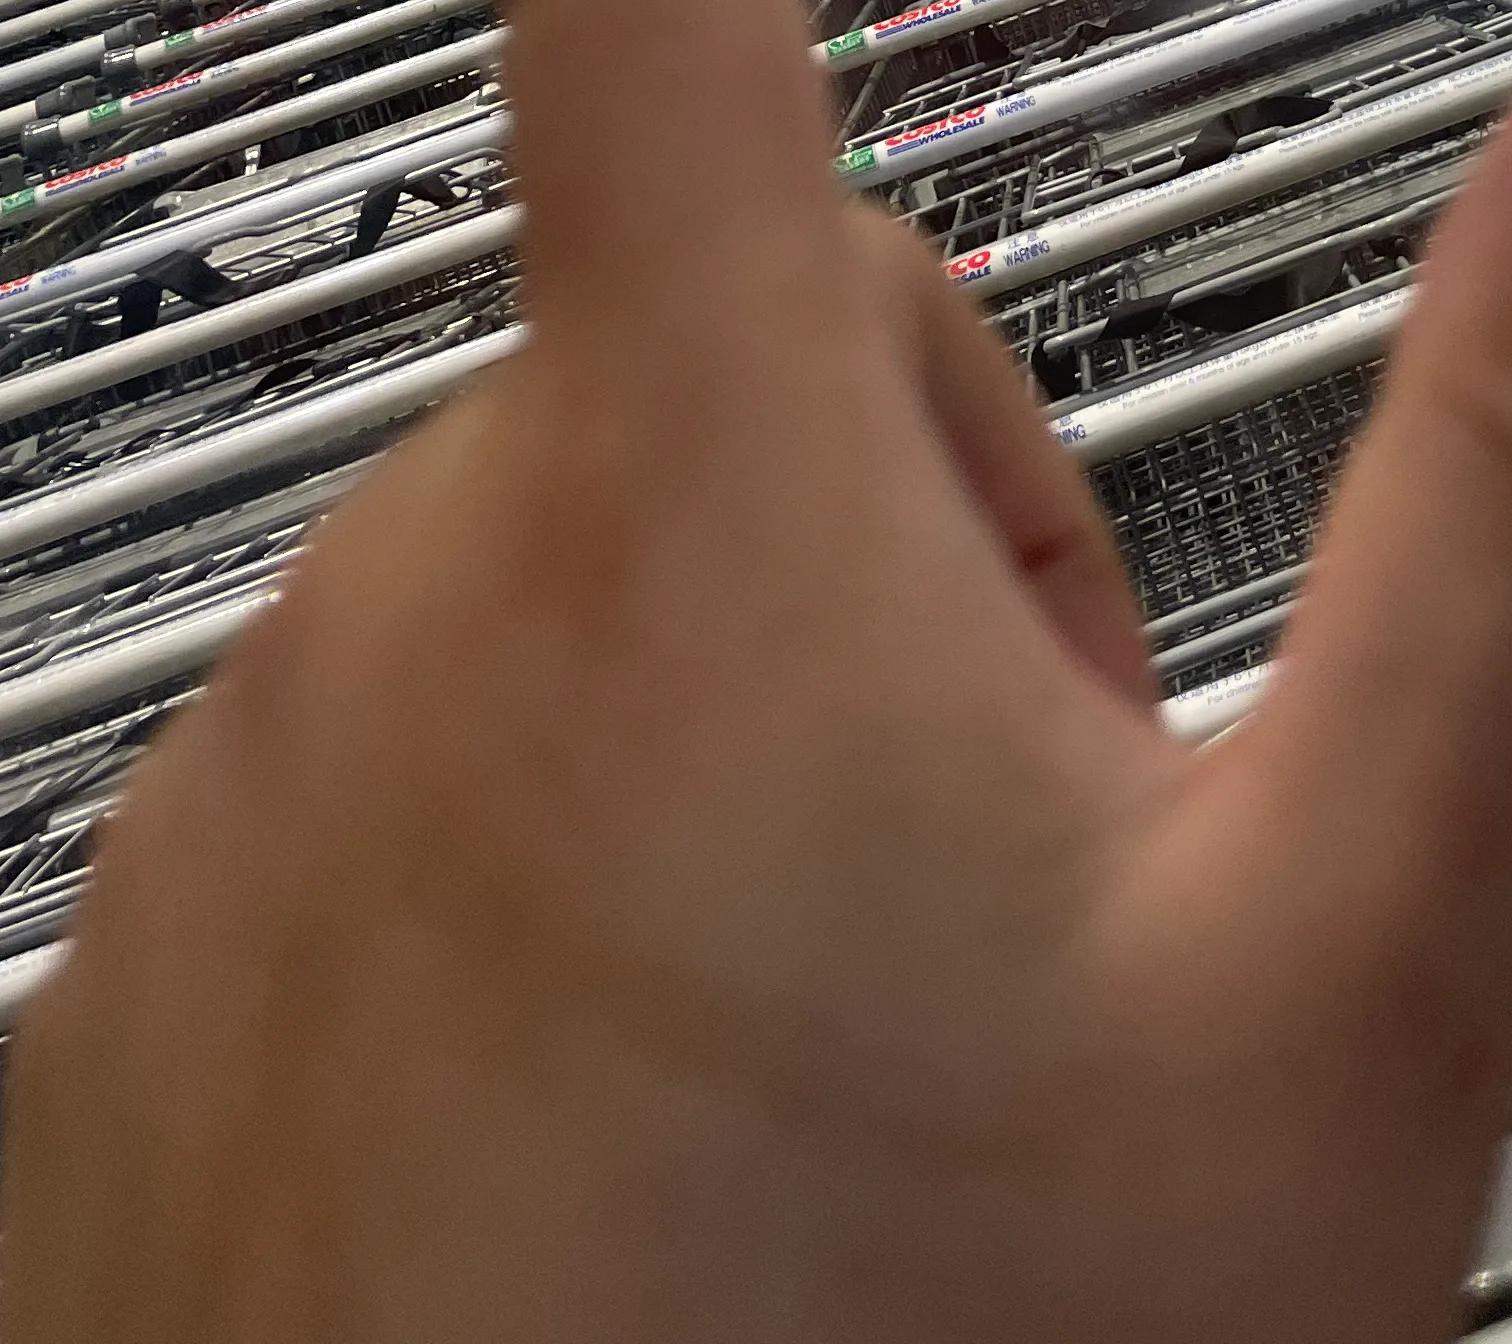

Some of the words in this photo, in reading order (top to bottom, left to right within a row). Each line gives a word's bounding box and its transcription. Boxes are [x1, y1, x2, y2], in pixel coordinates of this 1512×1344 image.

[902, 4, 962, 31] WHOLESALE
[995, 94, 1037, 118] WARNING
[885, 104, 987, 147] COSTCO
[918, 115, 986, 146] WHOLESALE
[1002, 239, 1051, 267] WARNING
